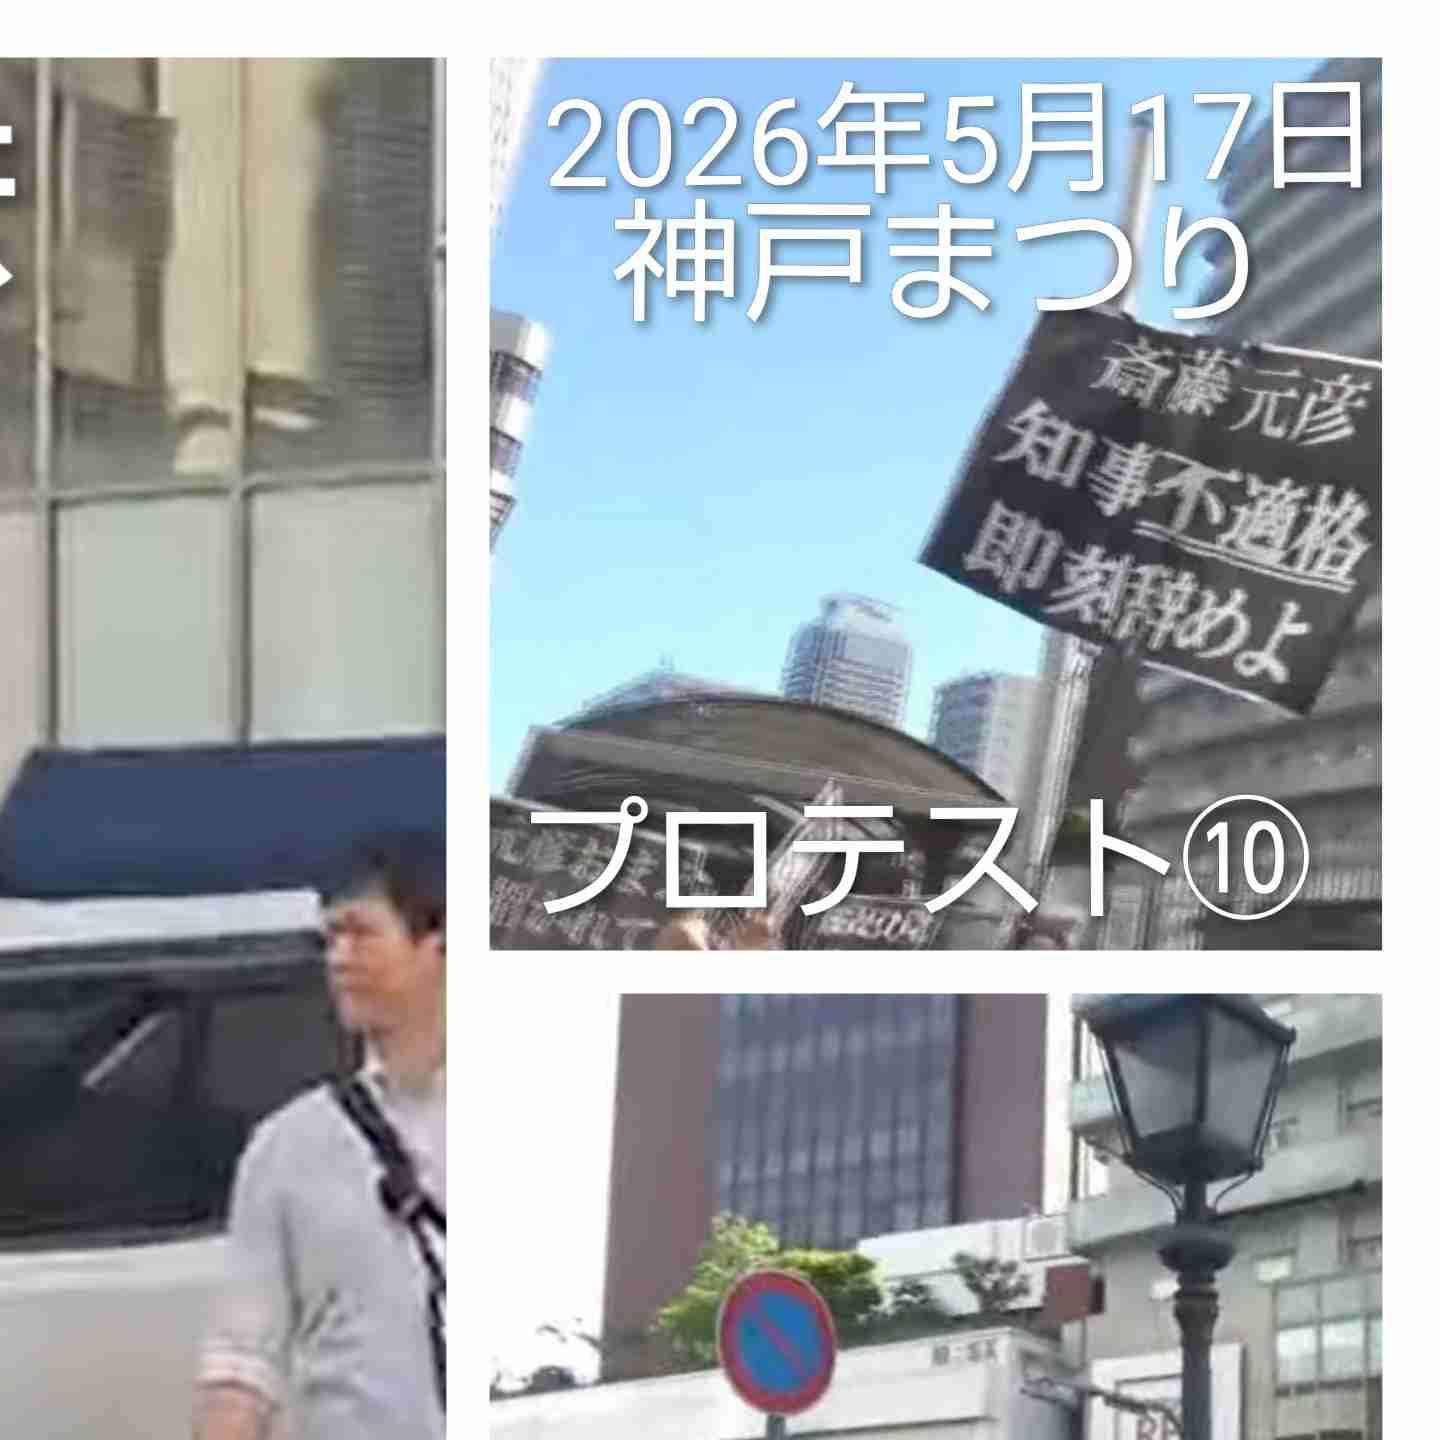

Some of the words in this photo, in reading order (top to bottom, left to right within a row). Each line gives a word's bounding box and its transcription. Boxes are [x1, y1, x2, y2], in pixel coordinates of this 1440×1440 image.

[994, 397, 1372, 582] 知事不適格
[962, 500, 1312, 684] 即刻辞めよ
